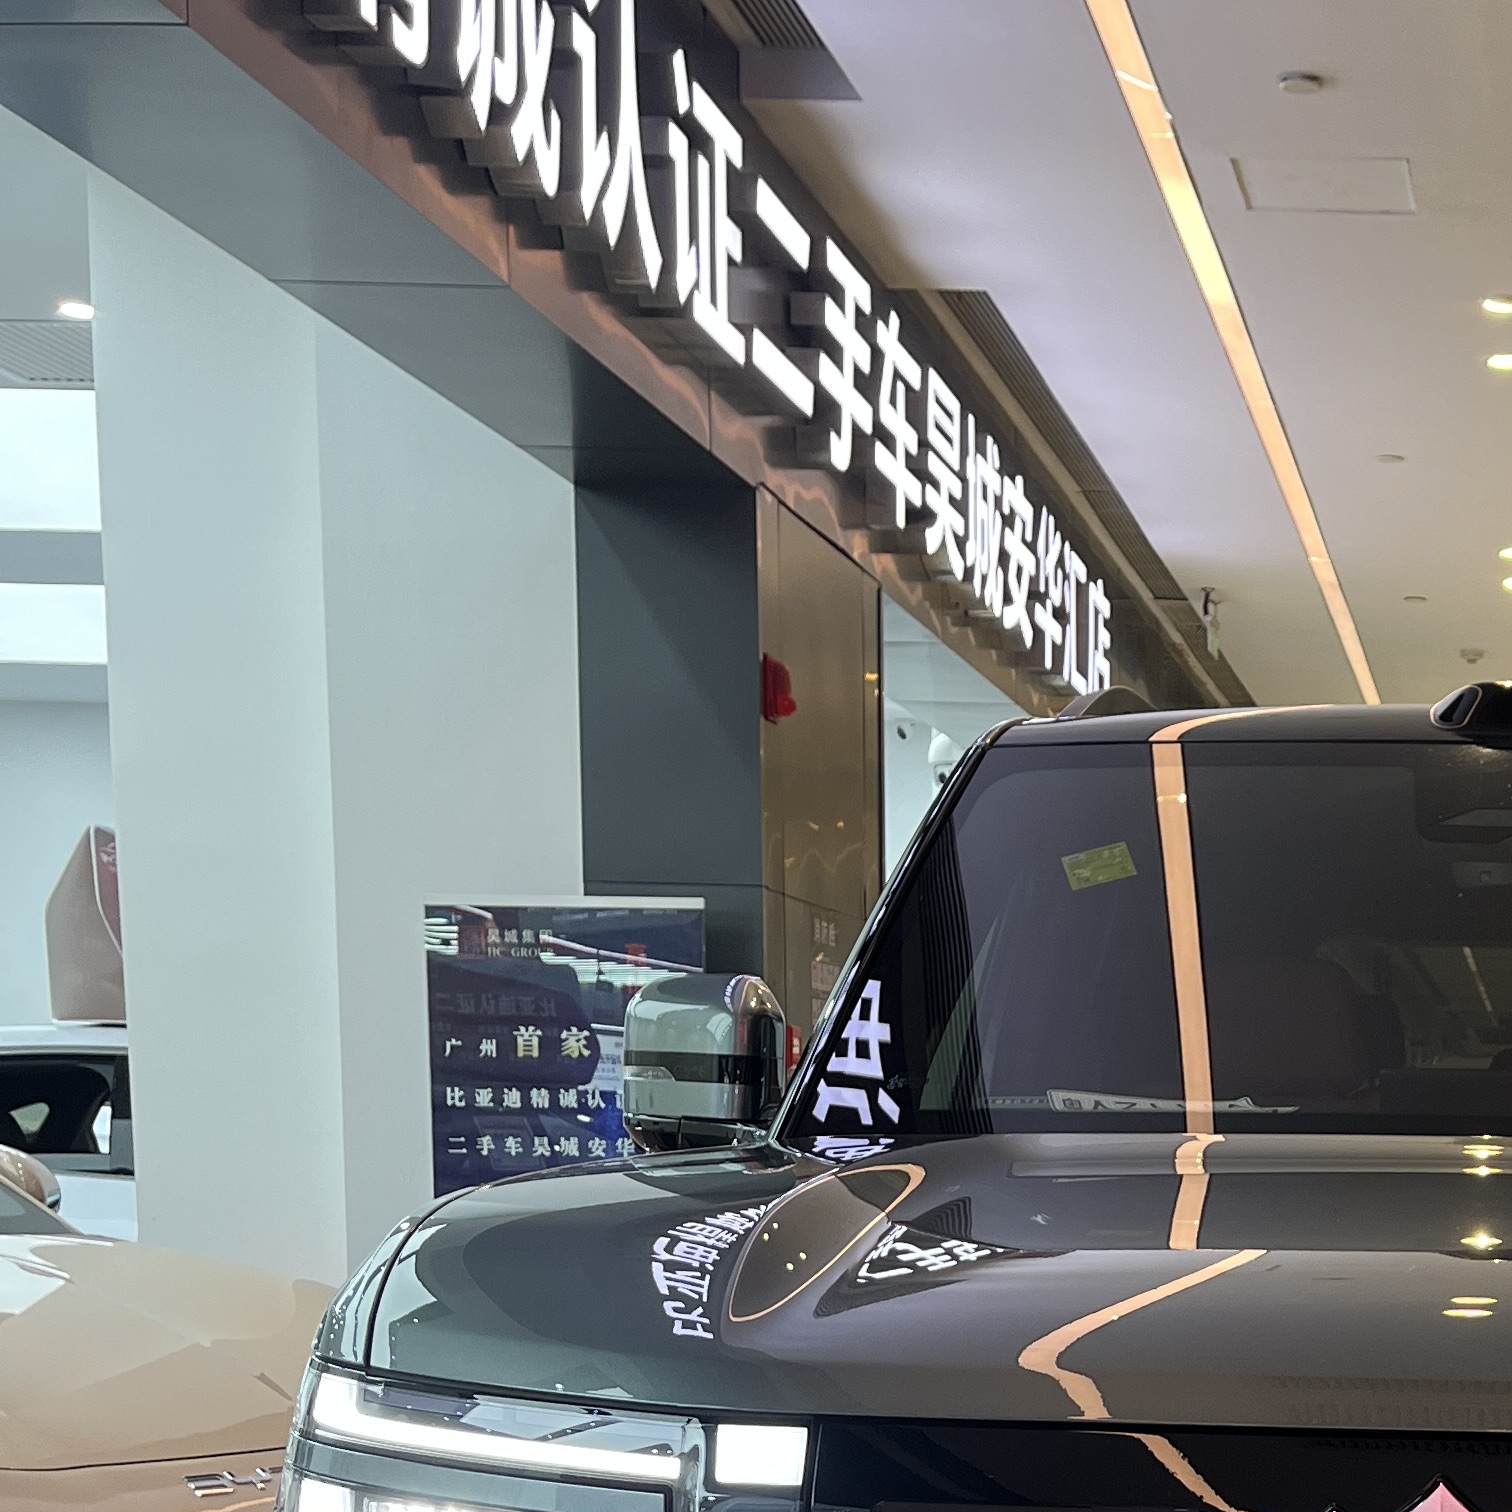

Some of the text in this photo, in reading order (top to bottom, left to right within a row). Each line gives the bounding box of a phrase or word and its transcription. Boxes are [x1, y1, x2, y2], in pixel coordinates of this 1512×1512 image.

[360, 0, 1112, 696] 诚认证二手车昊城安华汇店
[445, 1025, 592, 1058] 广州首家
[183, 1466, 282, 1497] BY
